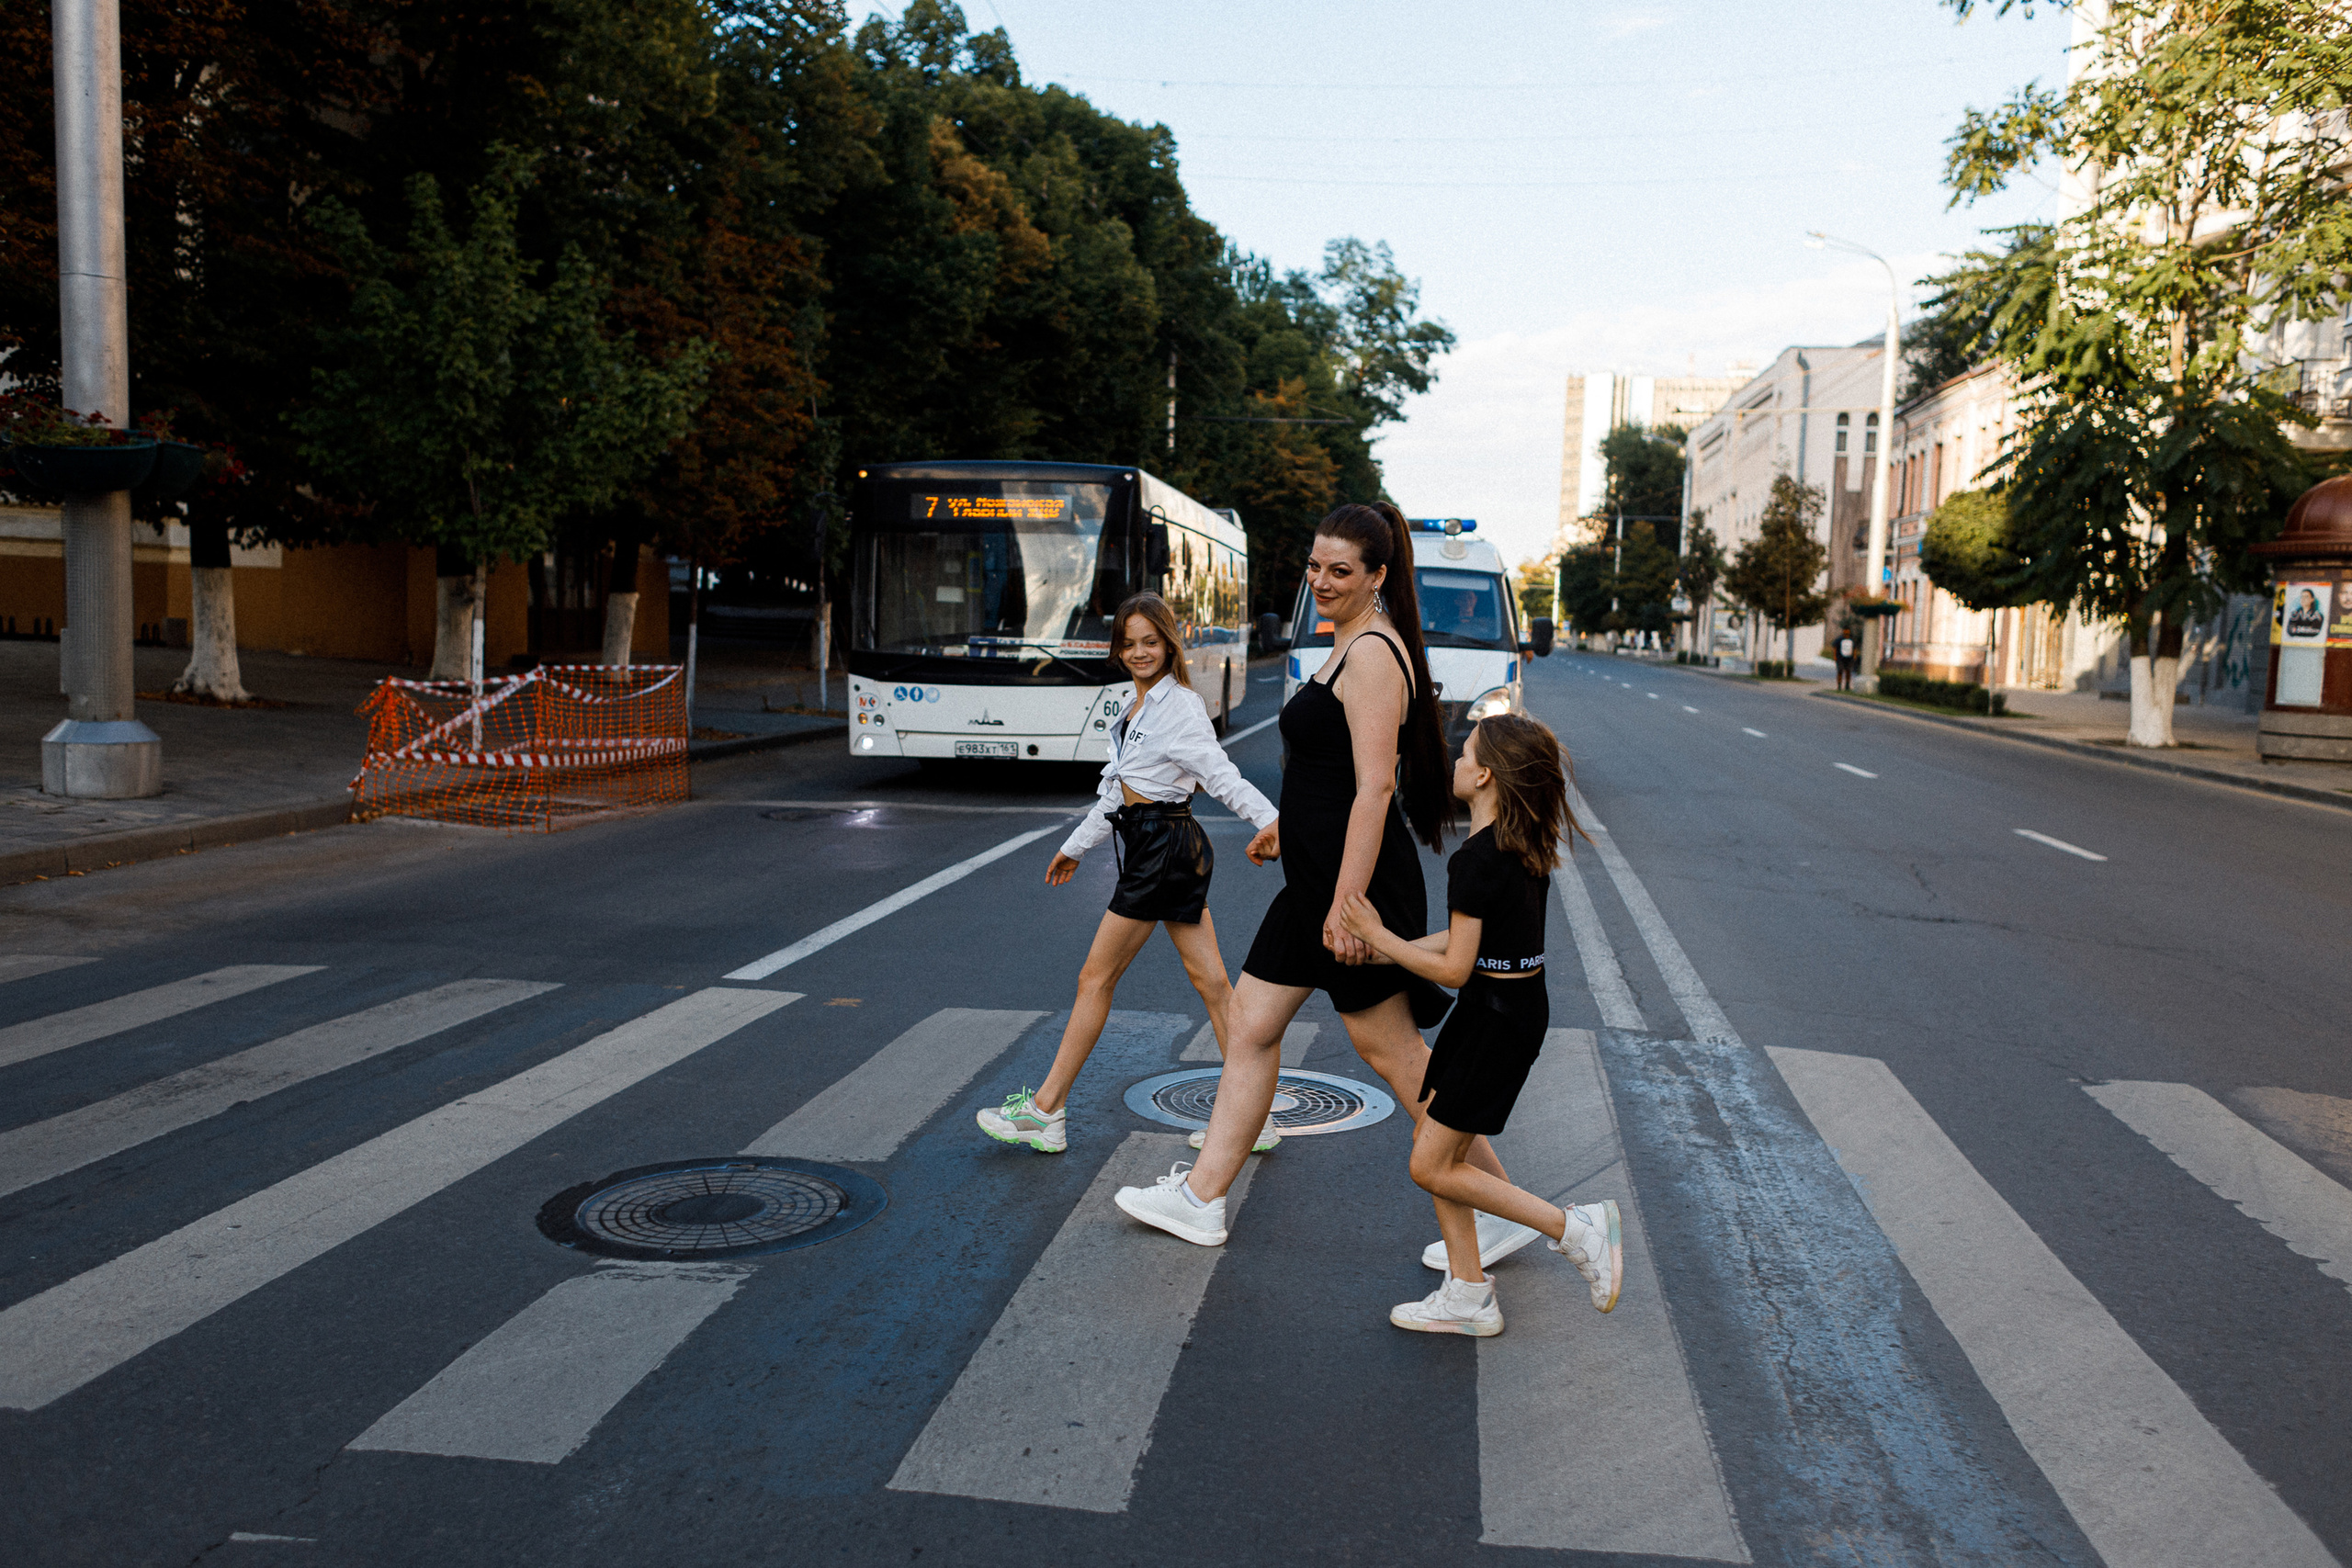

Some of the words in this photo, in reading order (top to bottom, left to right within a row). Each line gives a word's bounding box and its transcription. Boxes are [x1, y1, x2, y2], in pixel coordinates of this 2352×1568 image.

[925, 496, 939, 518] 7
[1103, 700, 1123, 716] 60
[1129, 729, 1147, 742] OF
[1476, 957, 1511, 970] ARIS
